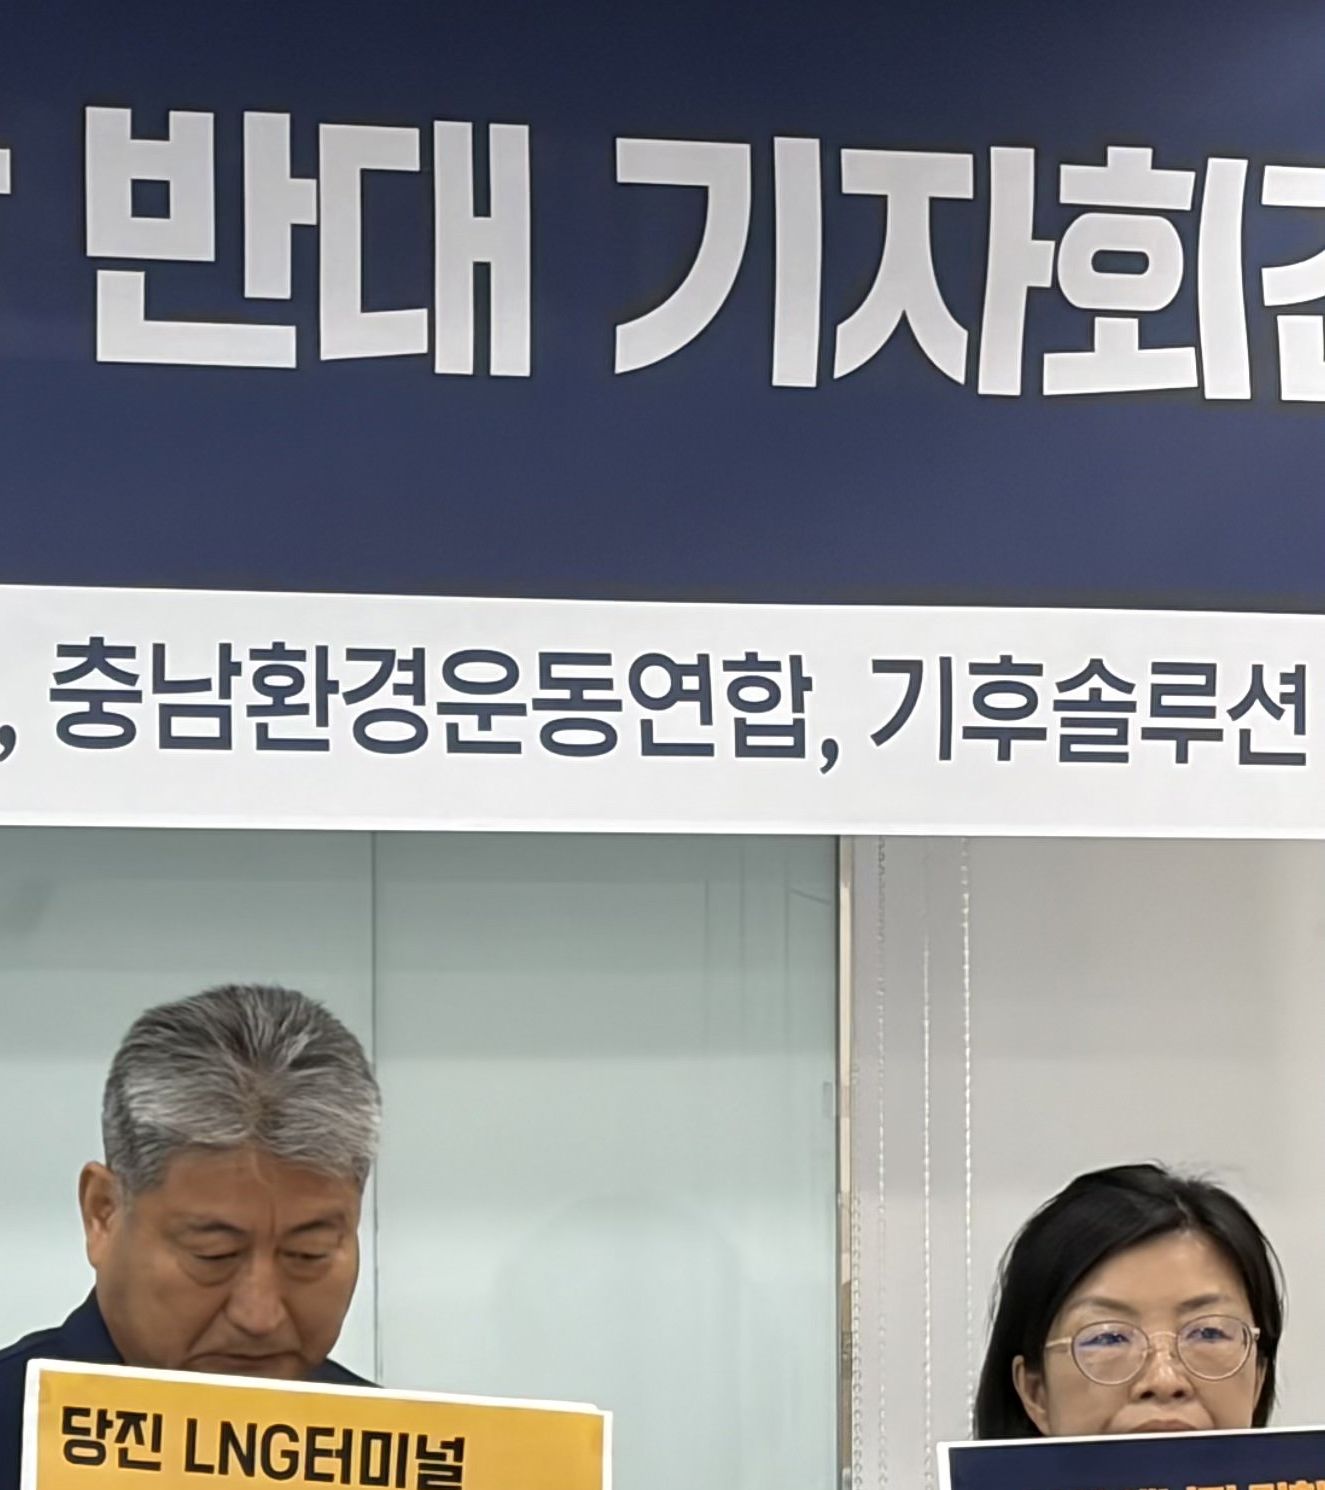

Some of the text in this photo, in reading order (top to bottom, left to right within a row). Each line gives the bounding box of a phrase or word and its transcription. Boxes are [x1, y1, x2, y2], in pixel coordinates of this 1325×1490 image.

[85, 105, 532, 377] 반대
[48, 636, 842, 775] 충남환경운동연합,
[869, 652, 1310, 768] 기후솔루션
[61, 1407, 163, 1472] 당진
